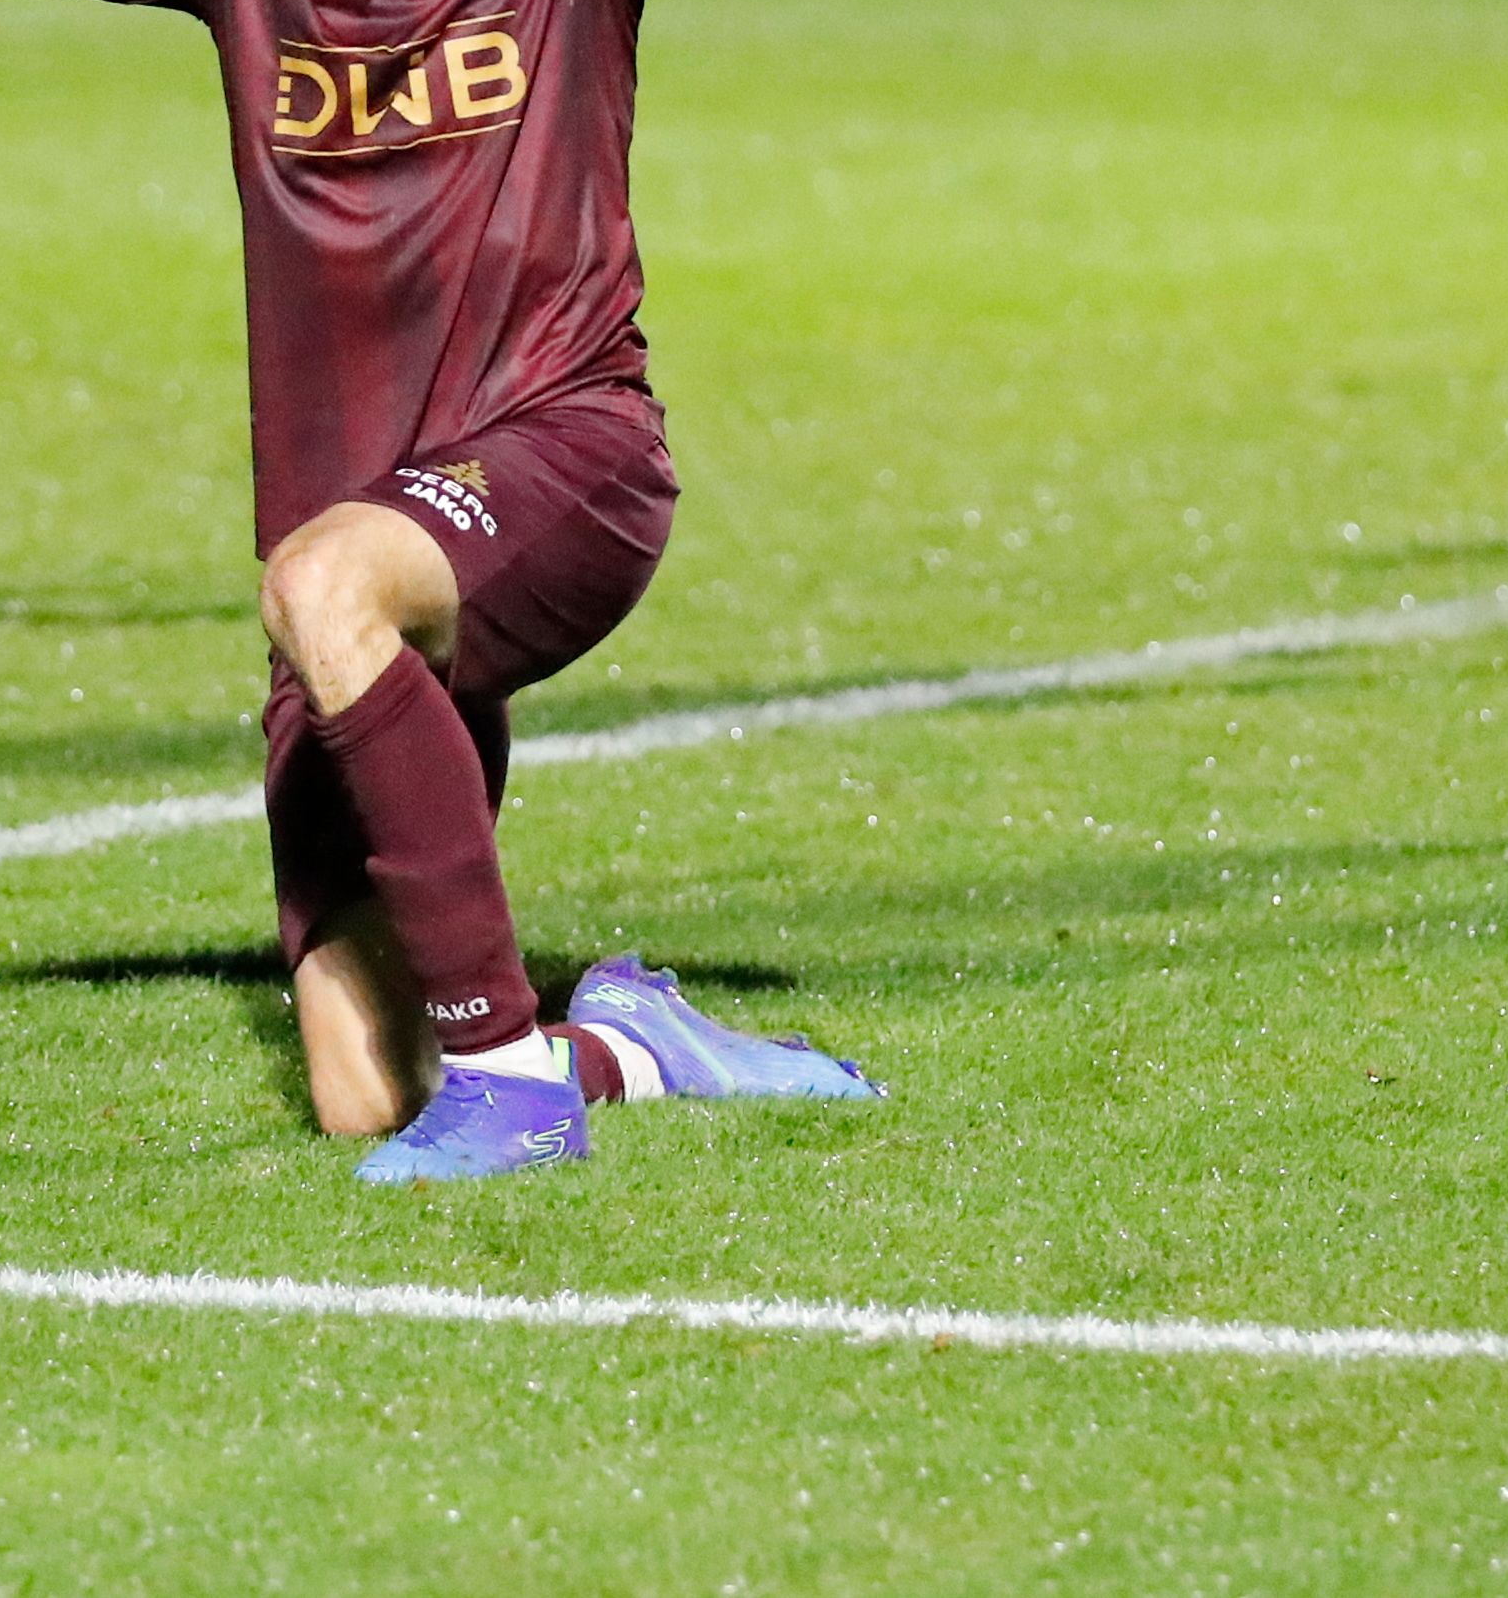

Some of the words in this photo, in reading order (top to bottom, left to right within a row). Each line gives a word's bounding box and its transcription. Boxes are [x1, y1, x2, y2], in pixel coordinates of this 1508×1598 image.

[273, 30, 527, 138] DWB
[403, 482, 472, 531] JAKO
[425, 996, 491, 1021] JAKO
